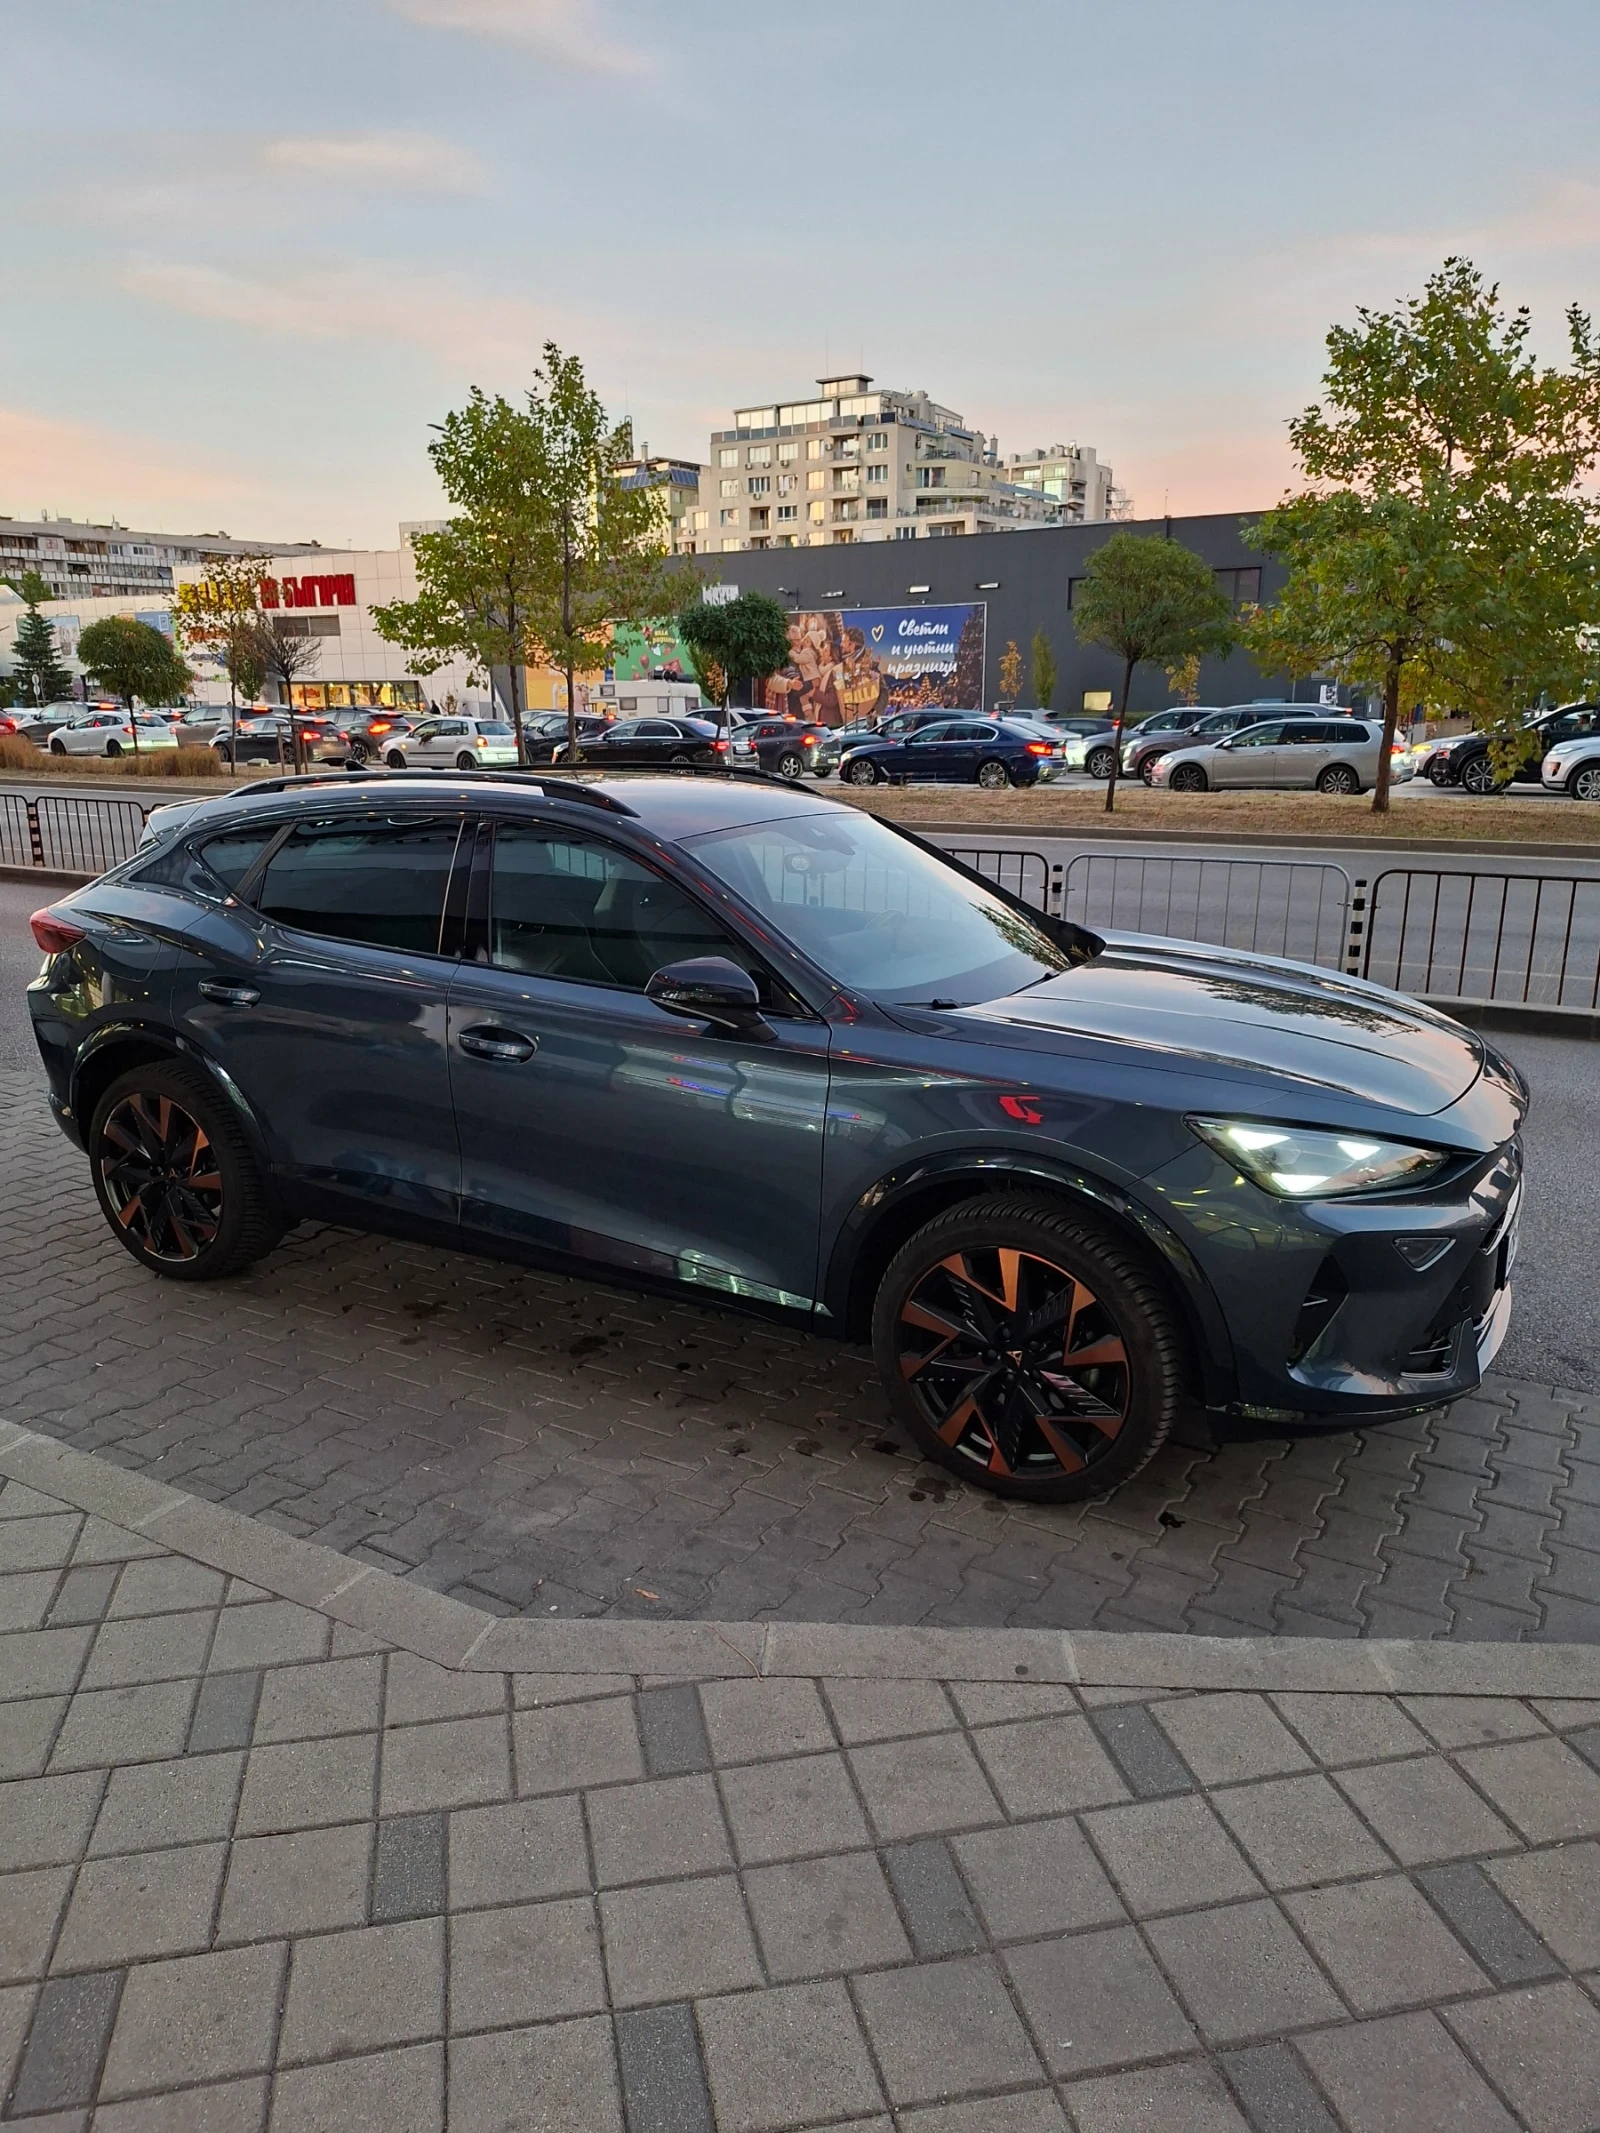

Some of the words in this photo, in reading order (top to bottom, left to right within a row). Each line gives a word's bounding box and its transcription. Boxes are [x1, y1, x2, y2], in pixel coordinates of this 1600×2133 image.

[282, 573, 356, 608] БЪЛГАРИЯ
[898, 619, 949, 636] Светли
[891, 645, 901, 656] и
[903, 641, 954, 660] уютни
[887, 661, 958, 680] празници
